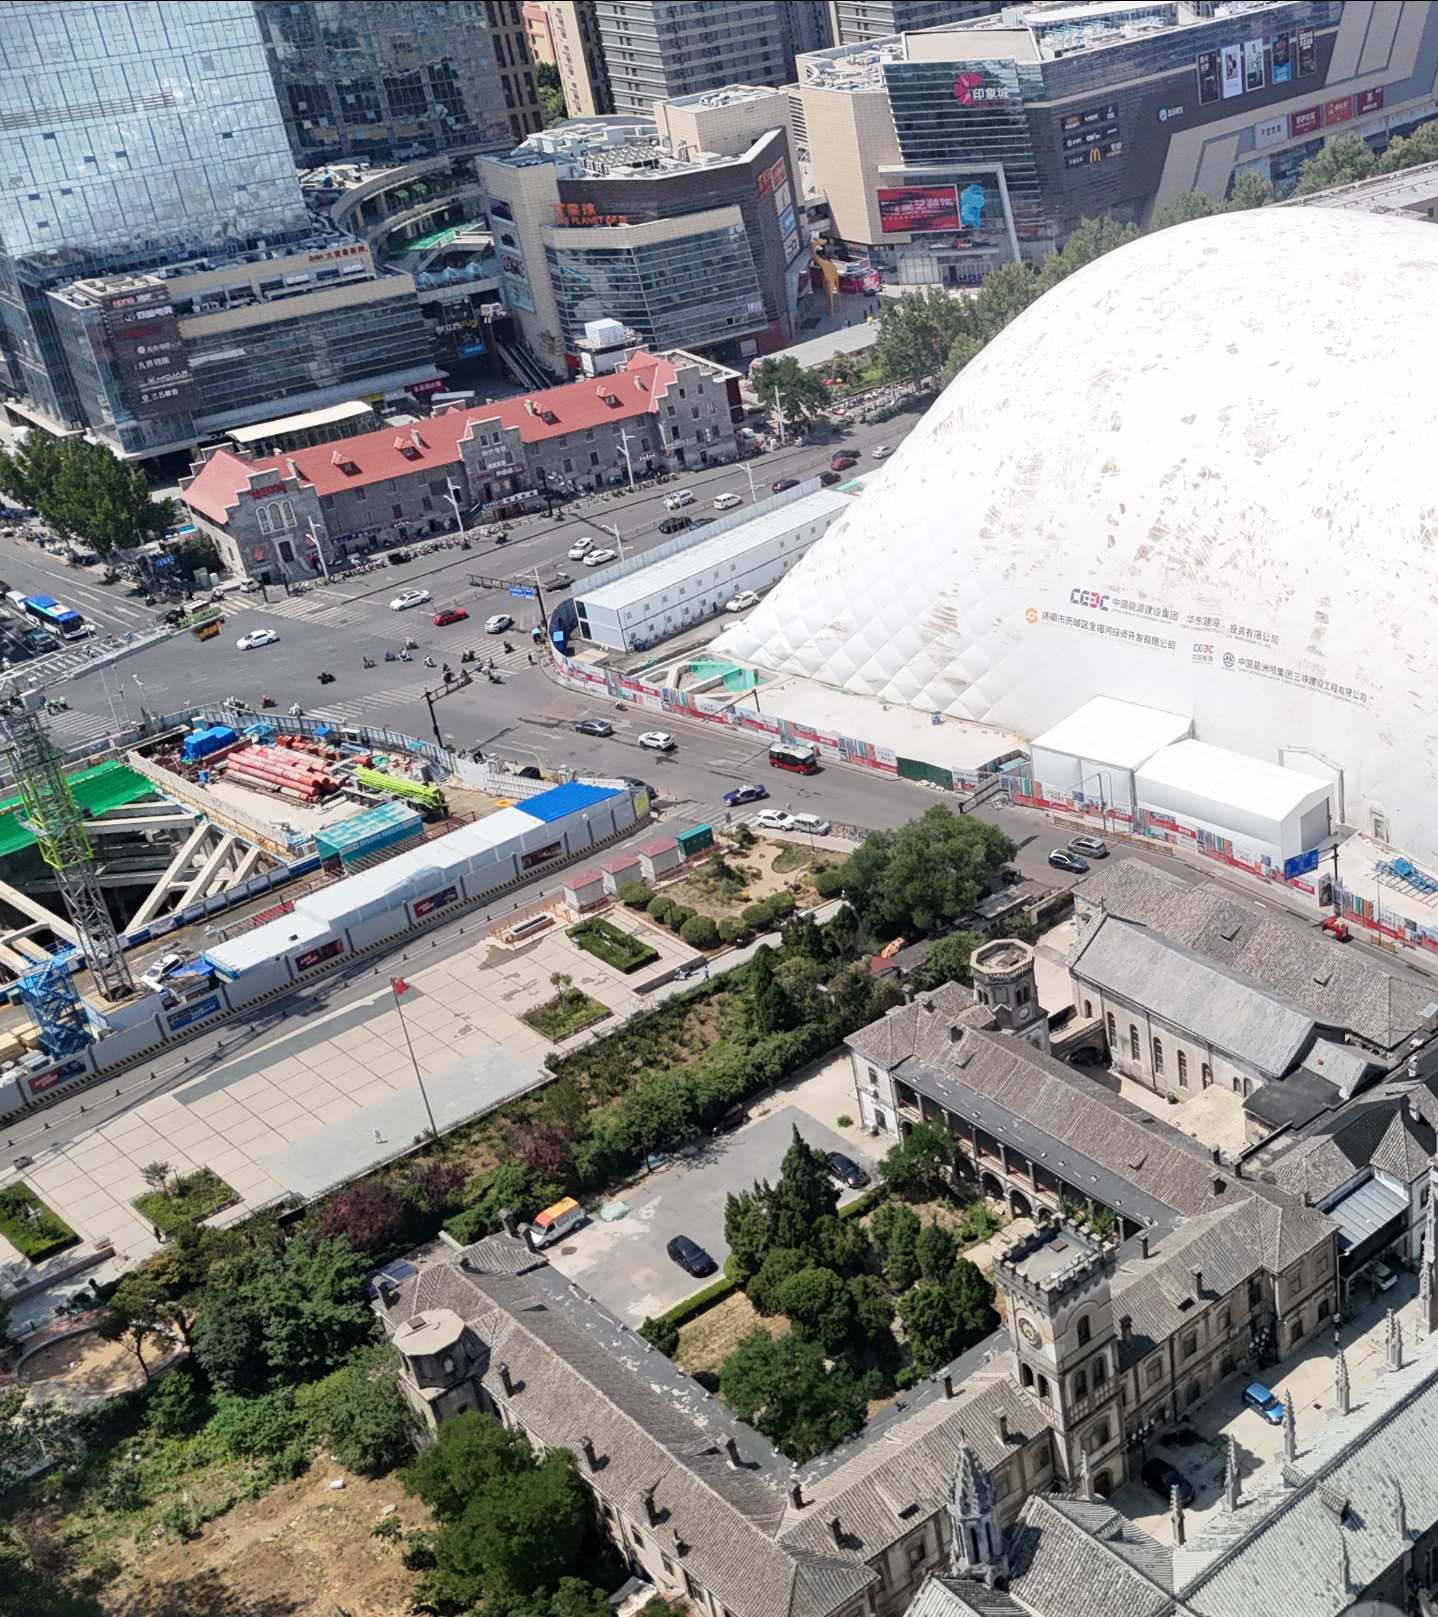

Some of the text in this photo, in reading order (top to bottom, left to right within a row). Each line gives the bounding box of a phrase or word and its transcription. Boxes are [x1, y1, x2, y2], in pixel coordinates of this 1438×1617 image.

[973, 87, 1009, 99] 印象城
[1112, 598, 1179, 621] 中国能源建设集团
[1229, 623, 1279, 645] 投资有限公司
